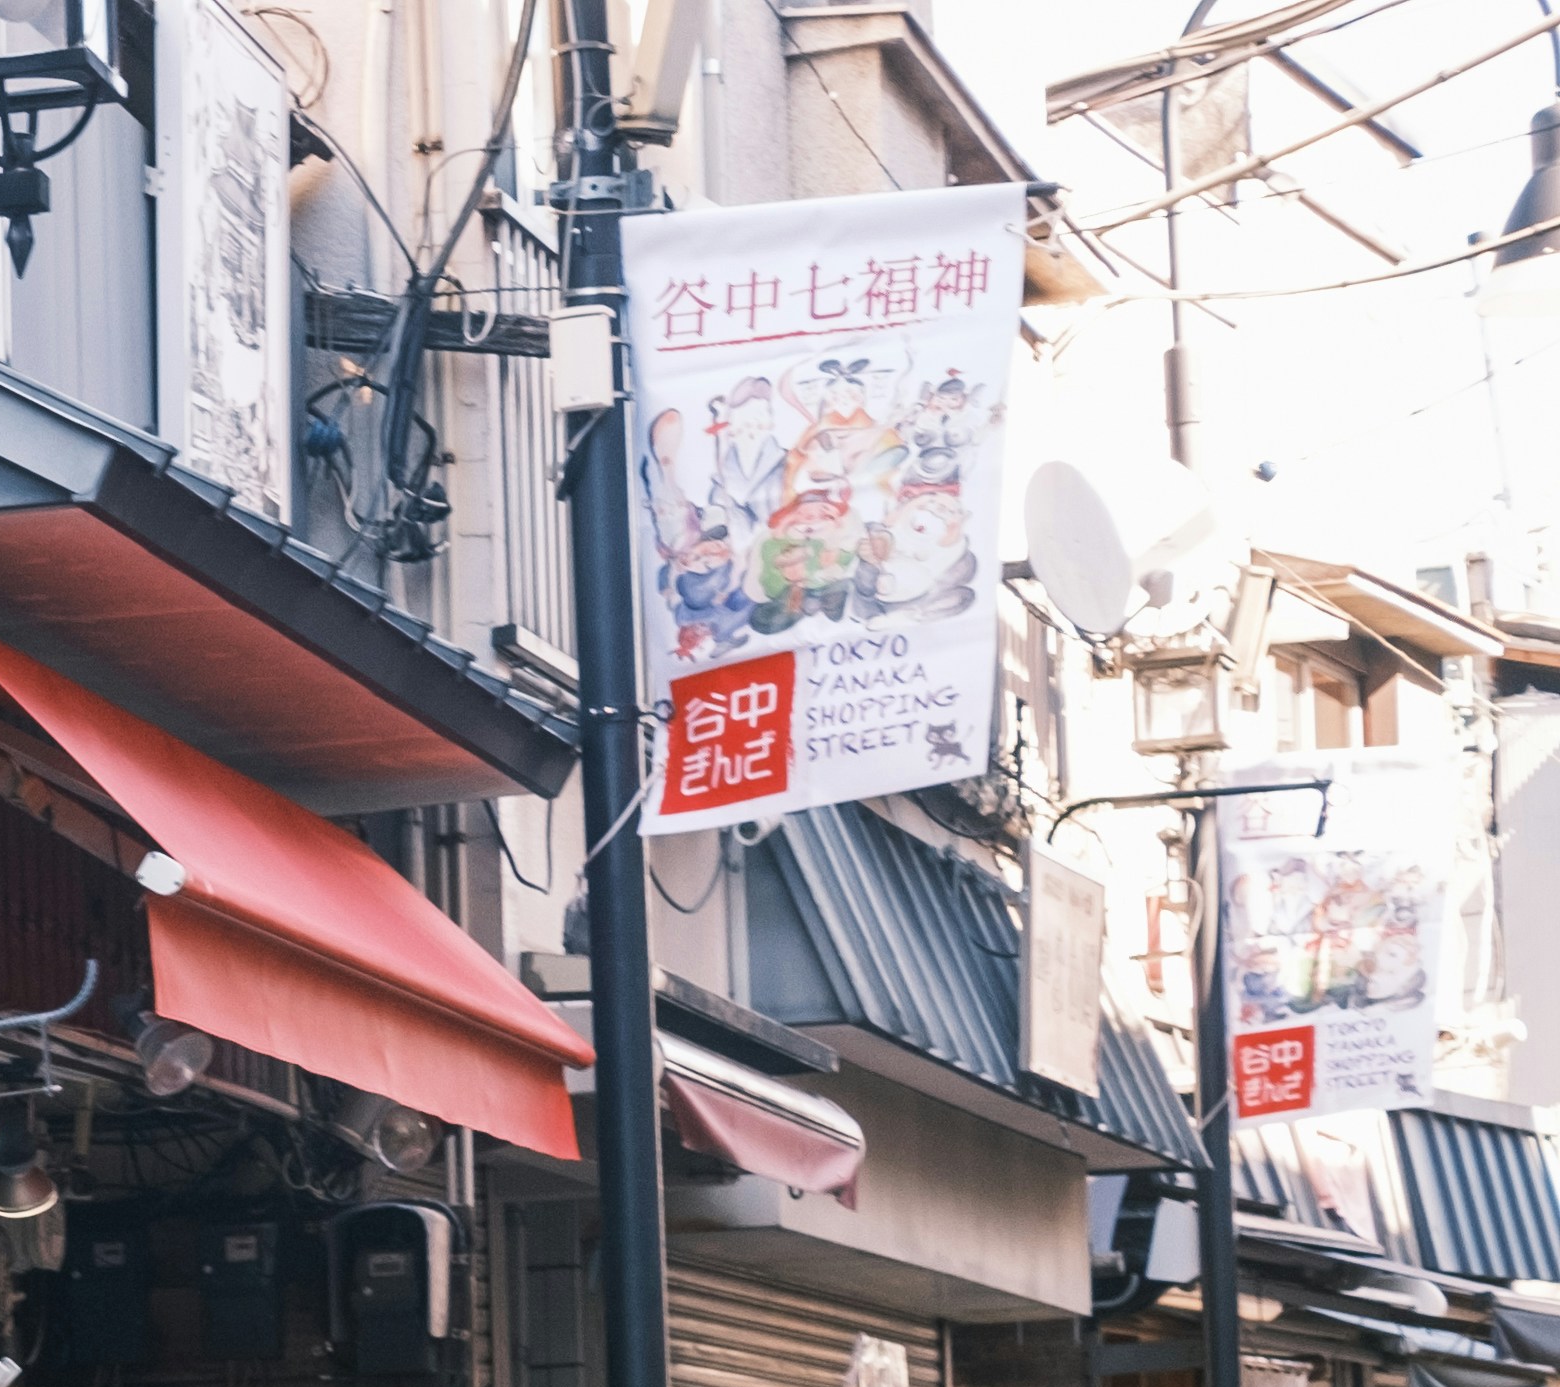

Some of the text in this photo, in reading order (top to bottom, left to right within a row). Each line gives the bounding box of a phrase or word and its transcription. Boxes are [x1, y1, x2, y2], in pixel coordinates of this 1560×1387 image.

[655, 248, 994, 341] 谷中七福神
[807, 632, 910, 670] TOKYO
[806, 663, 929, 697] YANAKA
[682, 681, 779, 745] 谷中
[806, 685, 961, 731] SHOPPING
[679, 730, 778, 799] ぎんざ
[806, 720, 920, 763] STREET
